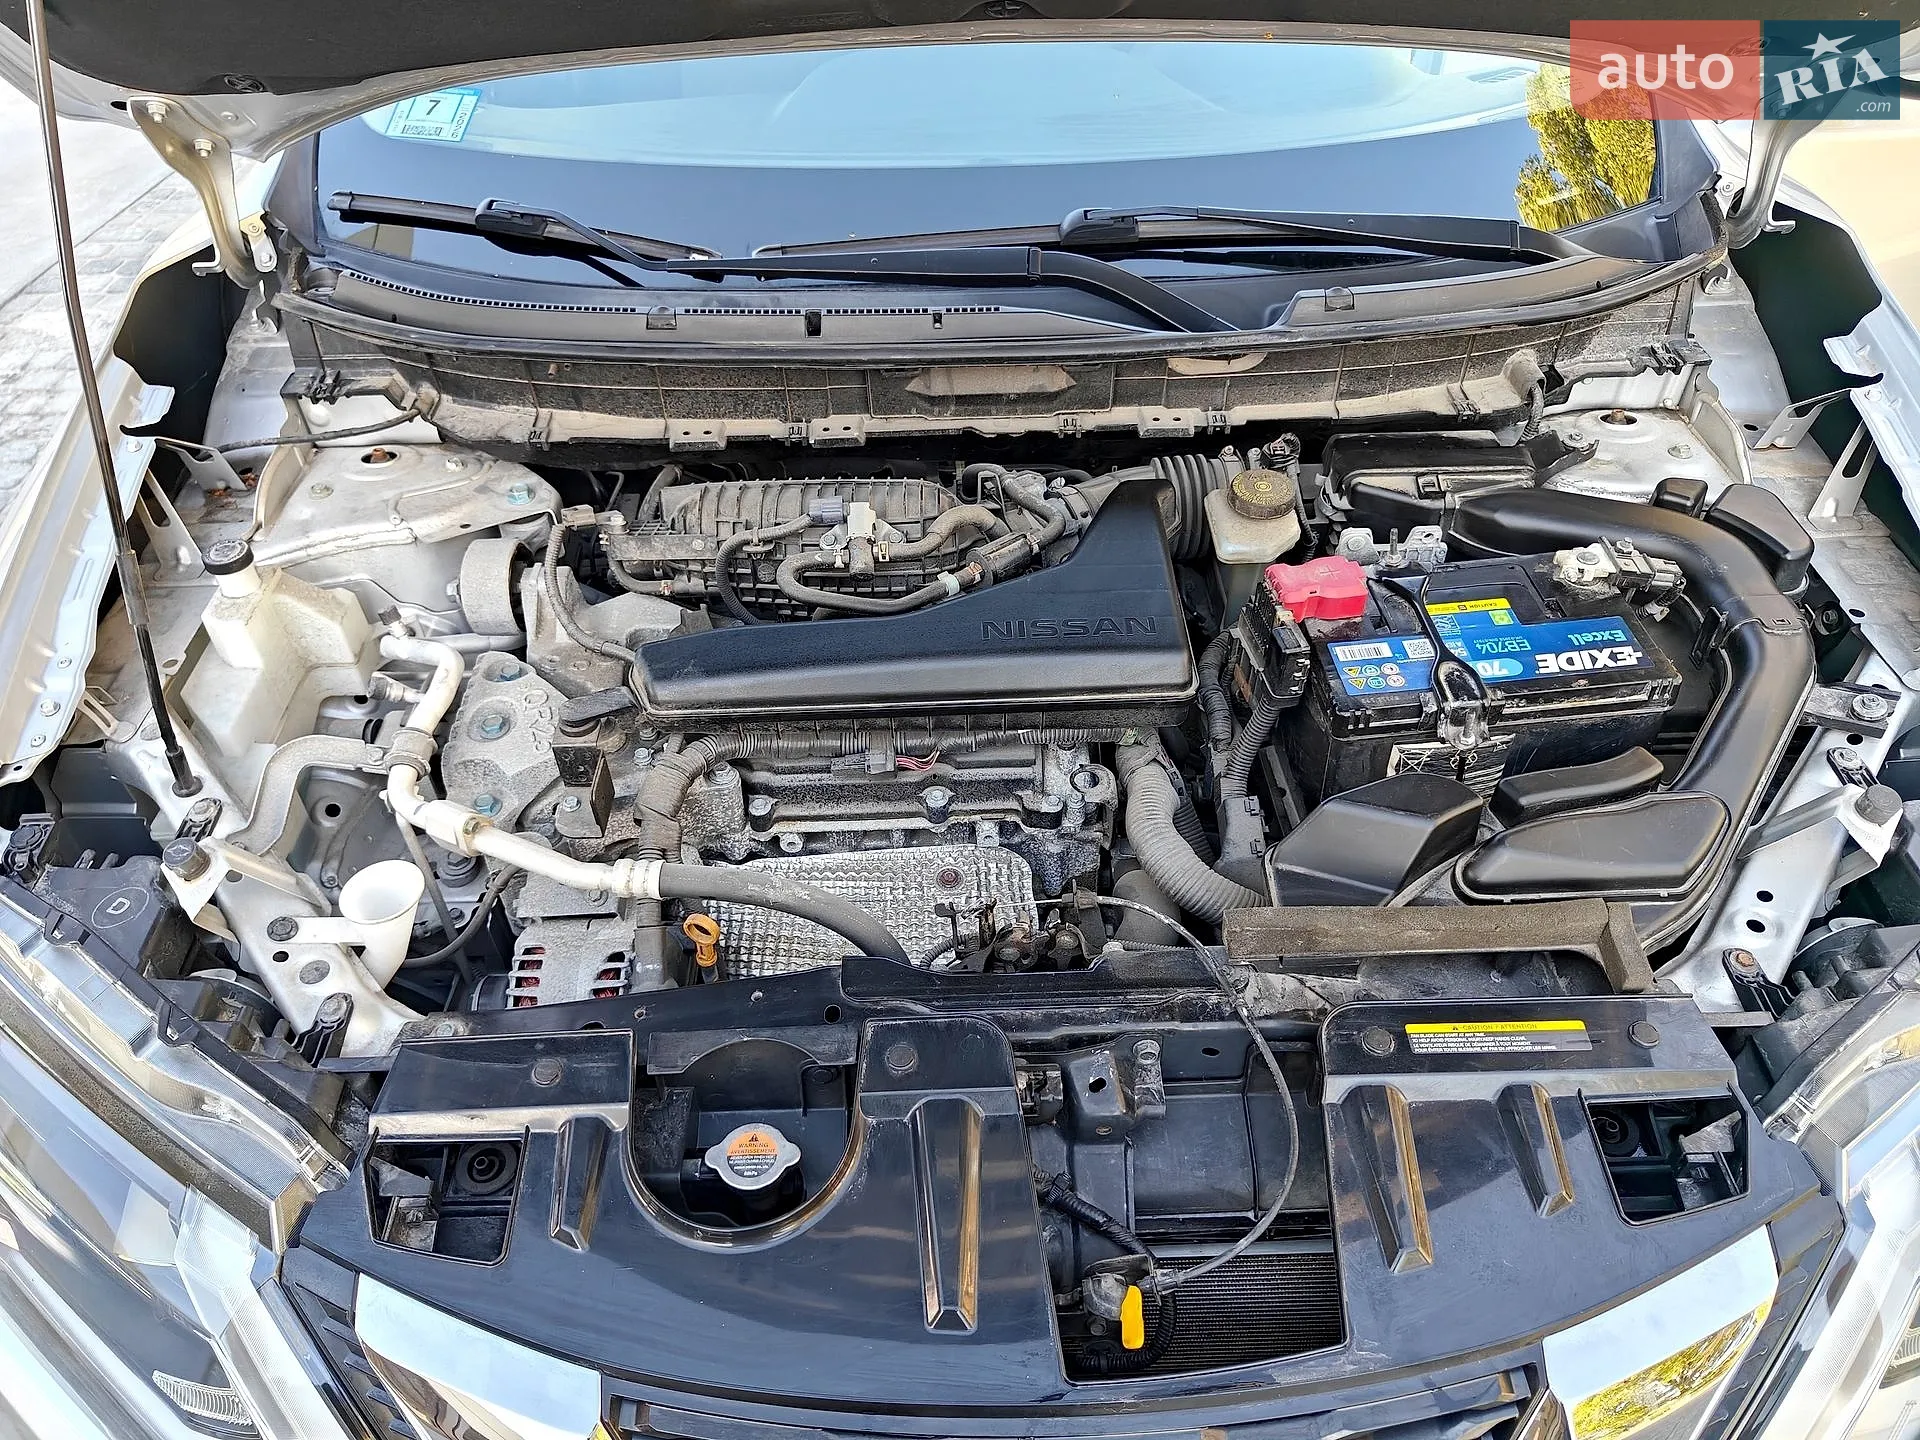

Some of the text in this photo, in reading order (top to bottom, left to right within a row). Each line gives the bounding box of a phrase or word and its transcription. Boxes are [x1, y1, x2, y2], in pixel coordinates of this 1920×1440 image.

[426, 99, 441, 116] 7
[981, 616, 1157, 641] NISSAN
[1567, 629, 1628, 646] Excell
[1475, 639, 1531, 654] EB704
[1534, 645, 1643, 674] EXIDE
